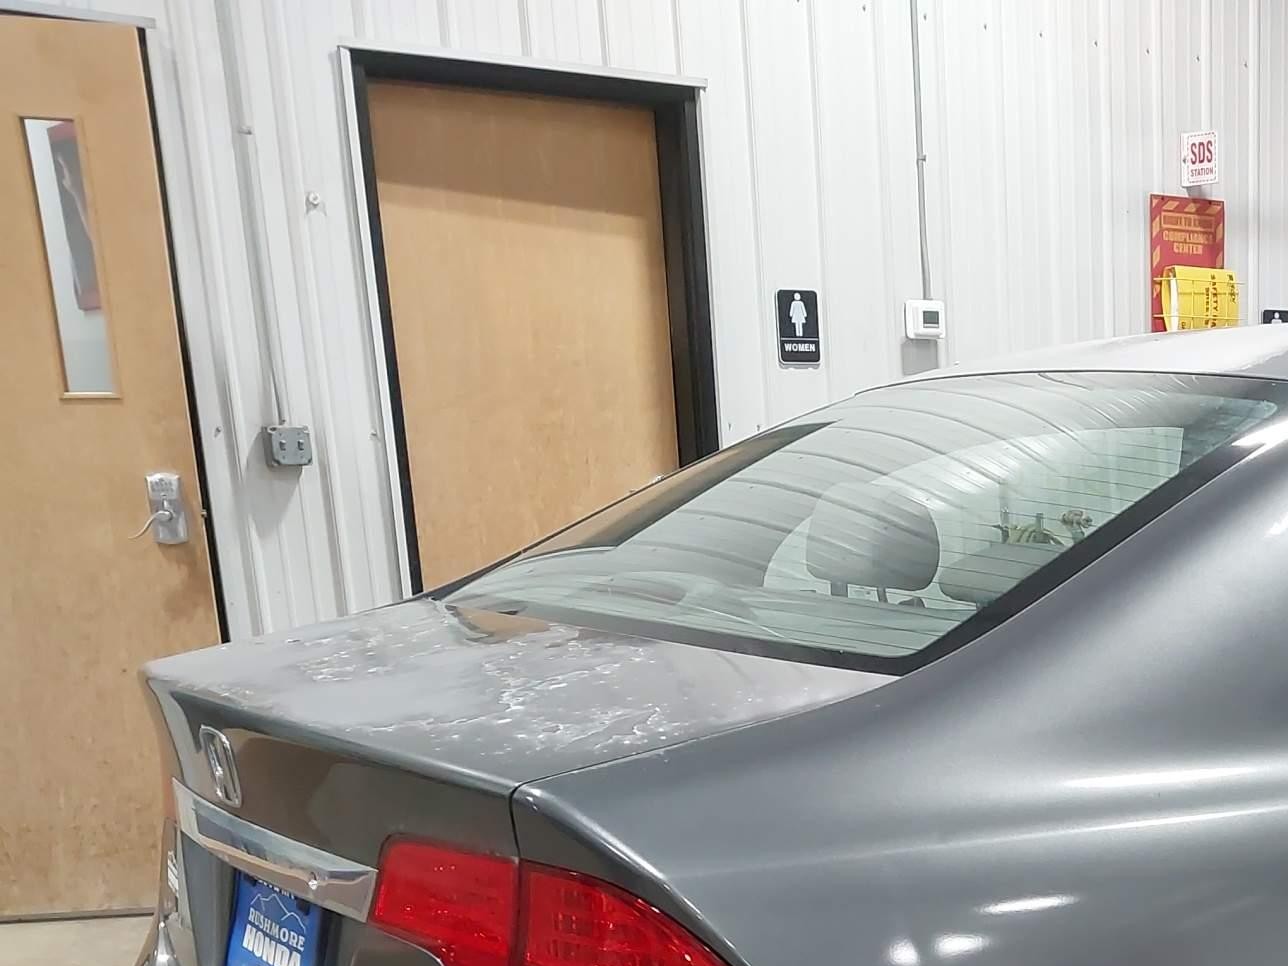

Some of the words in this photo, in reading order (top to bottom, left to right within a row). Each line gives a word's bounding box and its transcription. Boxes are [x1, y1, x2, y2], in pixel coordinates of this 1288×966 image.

[1190, 140, 1213, 165] SDS
[1190, 167, 1214, 177] STATION
[1173, 242, 1203, 255] CENTER
[784, 343, 816, 352] WOMEN
[248, 907, 305, 951] RUSHMORE
